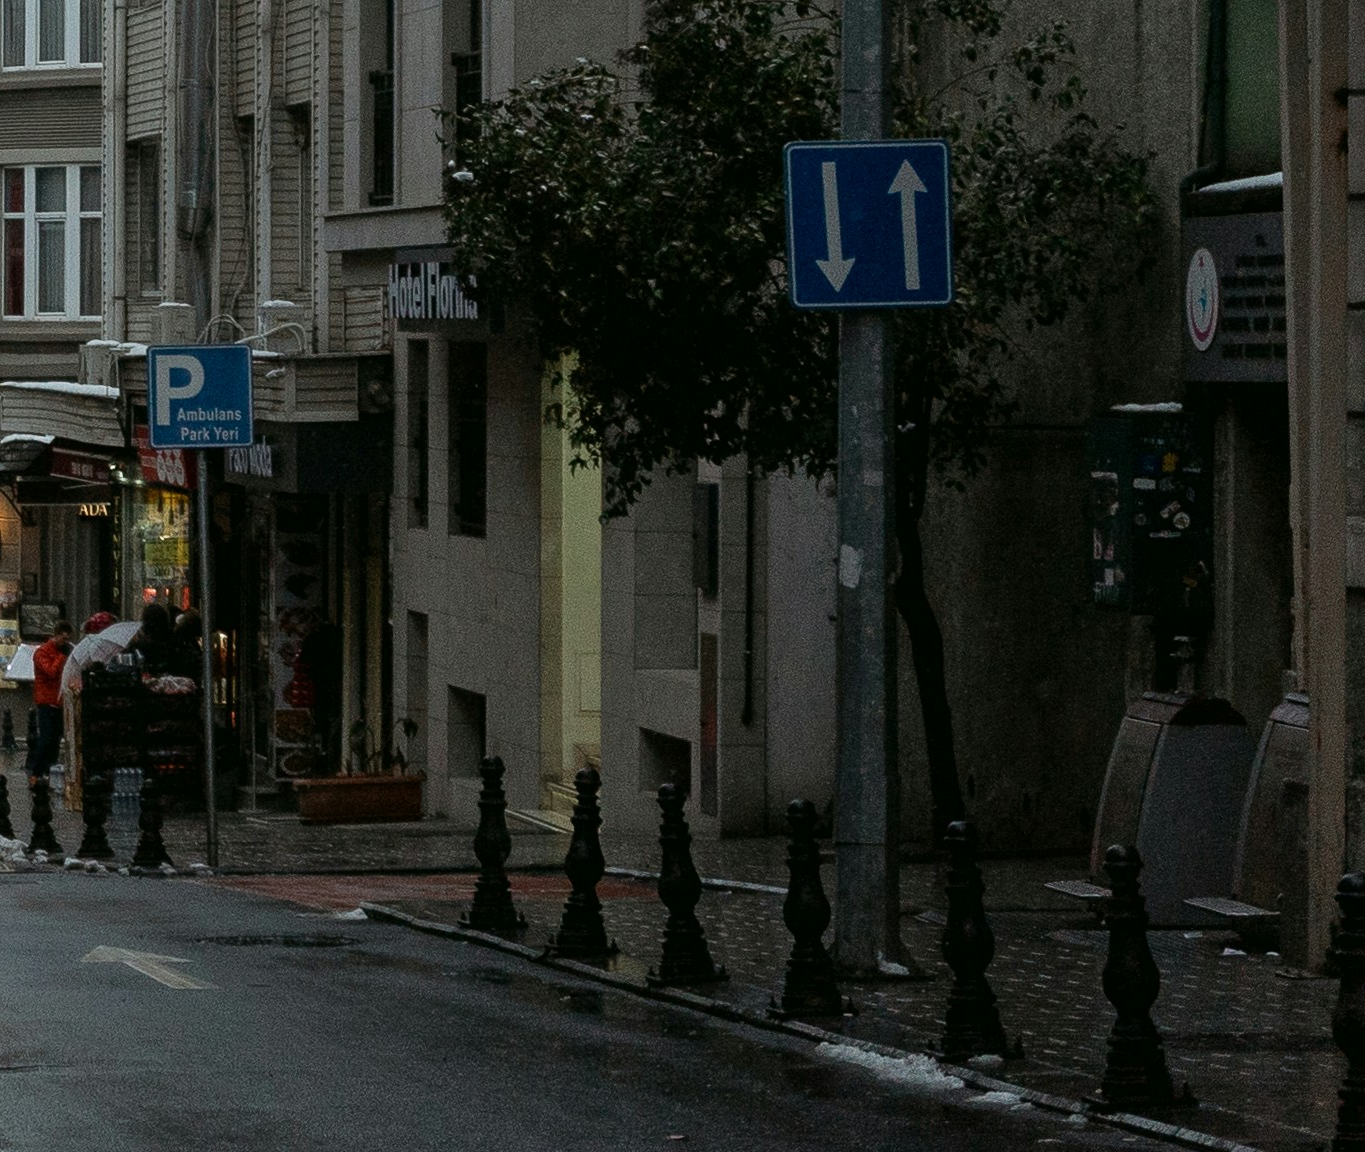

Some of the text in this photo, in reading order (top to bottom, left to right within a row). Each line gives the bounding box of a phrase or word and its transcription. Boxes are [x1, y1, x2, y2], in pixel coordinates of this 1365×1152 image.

[389, 262, 426, 320] Hotel
[156, 354, 205, 426] P
[177, 408, 243, 422] Ambulans
[180, 427, 239, 441] Park Yeri
[78, 503, 109, 517] ADA
